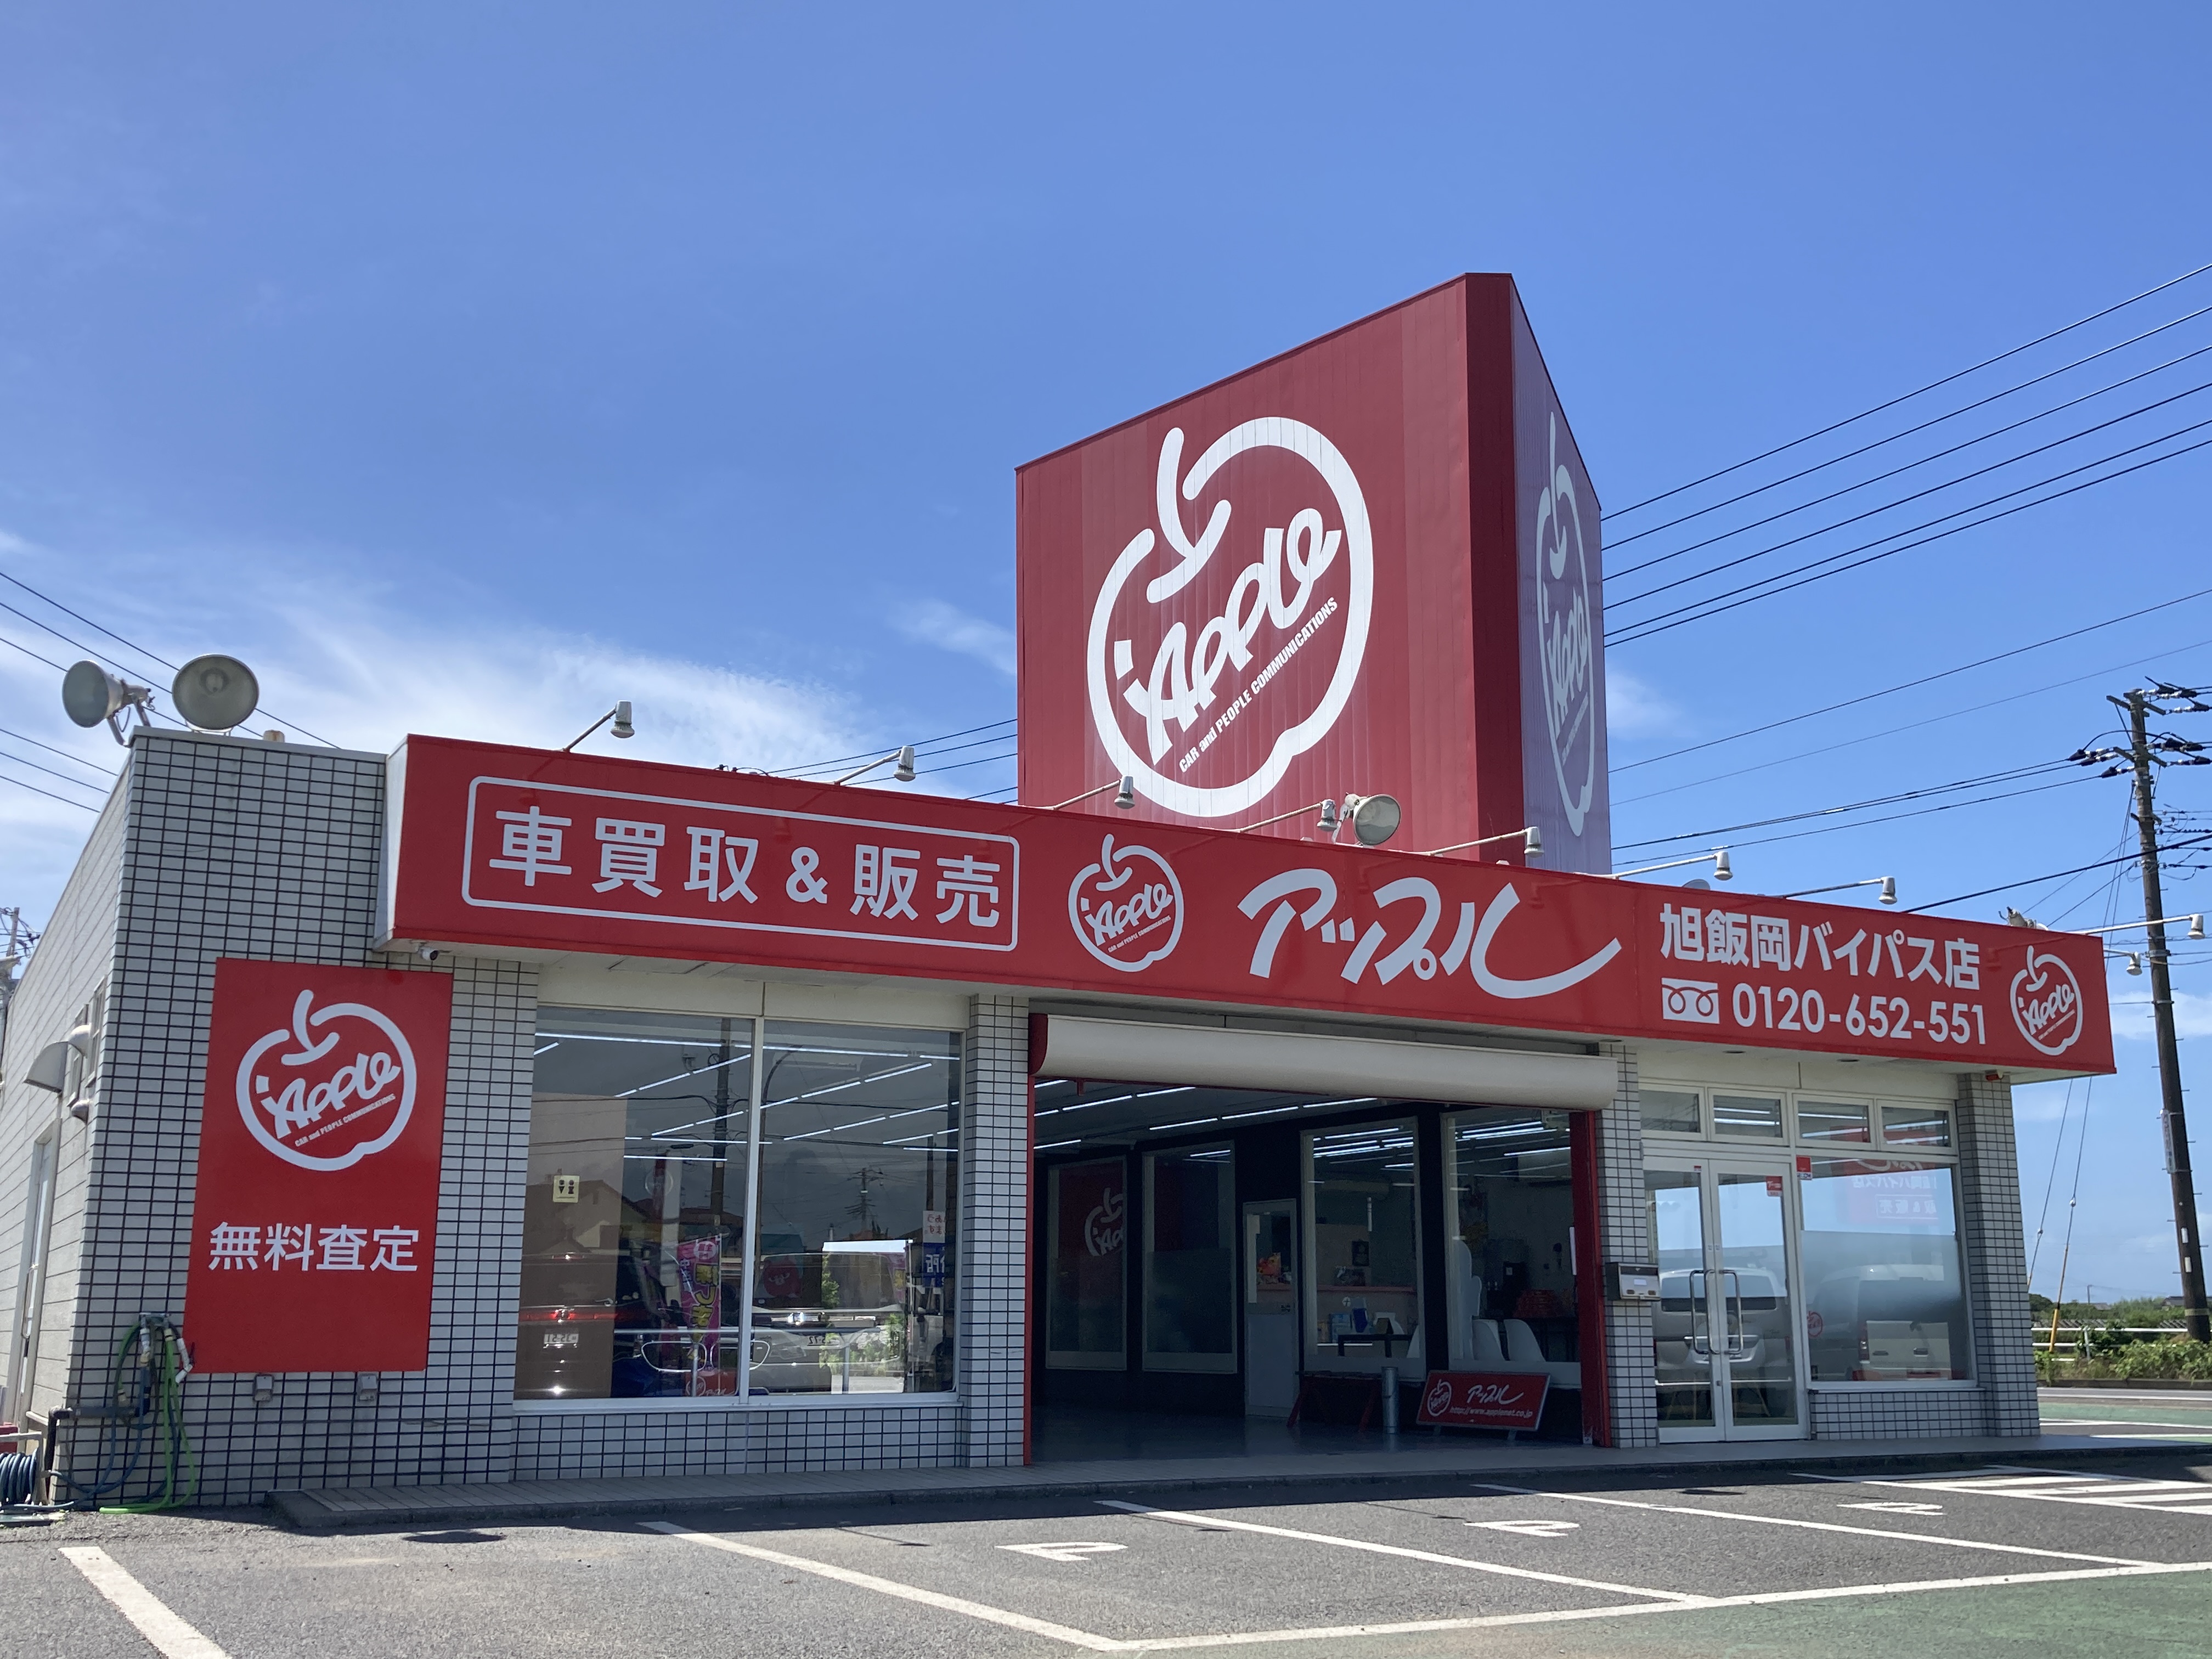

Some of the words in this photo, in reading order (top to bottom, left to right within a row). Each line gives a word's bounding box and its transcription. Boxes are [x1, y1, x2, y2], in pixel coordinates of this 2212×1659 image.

[1114, 508, 1342, 766] Apple
[1179, 747, 1200, 772] CAR
[1199, 726, 1217, 752] and
[1215, 689, 1252, 733] PEOPLE
[1251, 596, 1338, 694] COMMUNICATIONS
[489, 805, 1001, 928] 車買取&販売
[1080, 883, 1173, 947] Apple
[1237, 868, 1622, 999] アップル
[1660, 902, 1980, 991] 旭飯岡バイパス店
[1732, 982, 1987, 1045] 0120-652-551
[2018, 984, 2075, 1035] Apple
[256, 1052, 402, 1139] Apple
[207, 1221, 419, 1273] 無料査定
